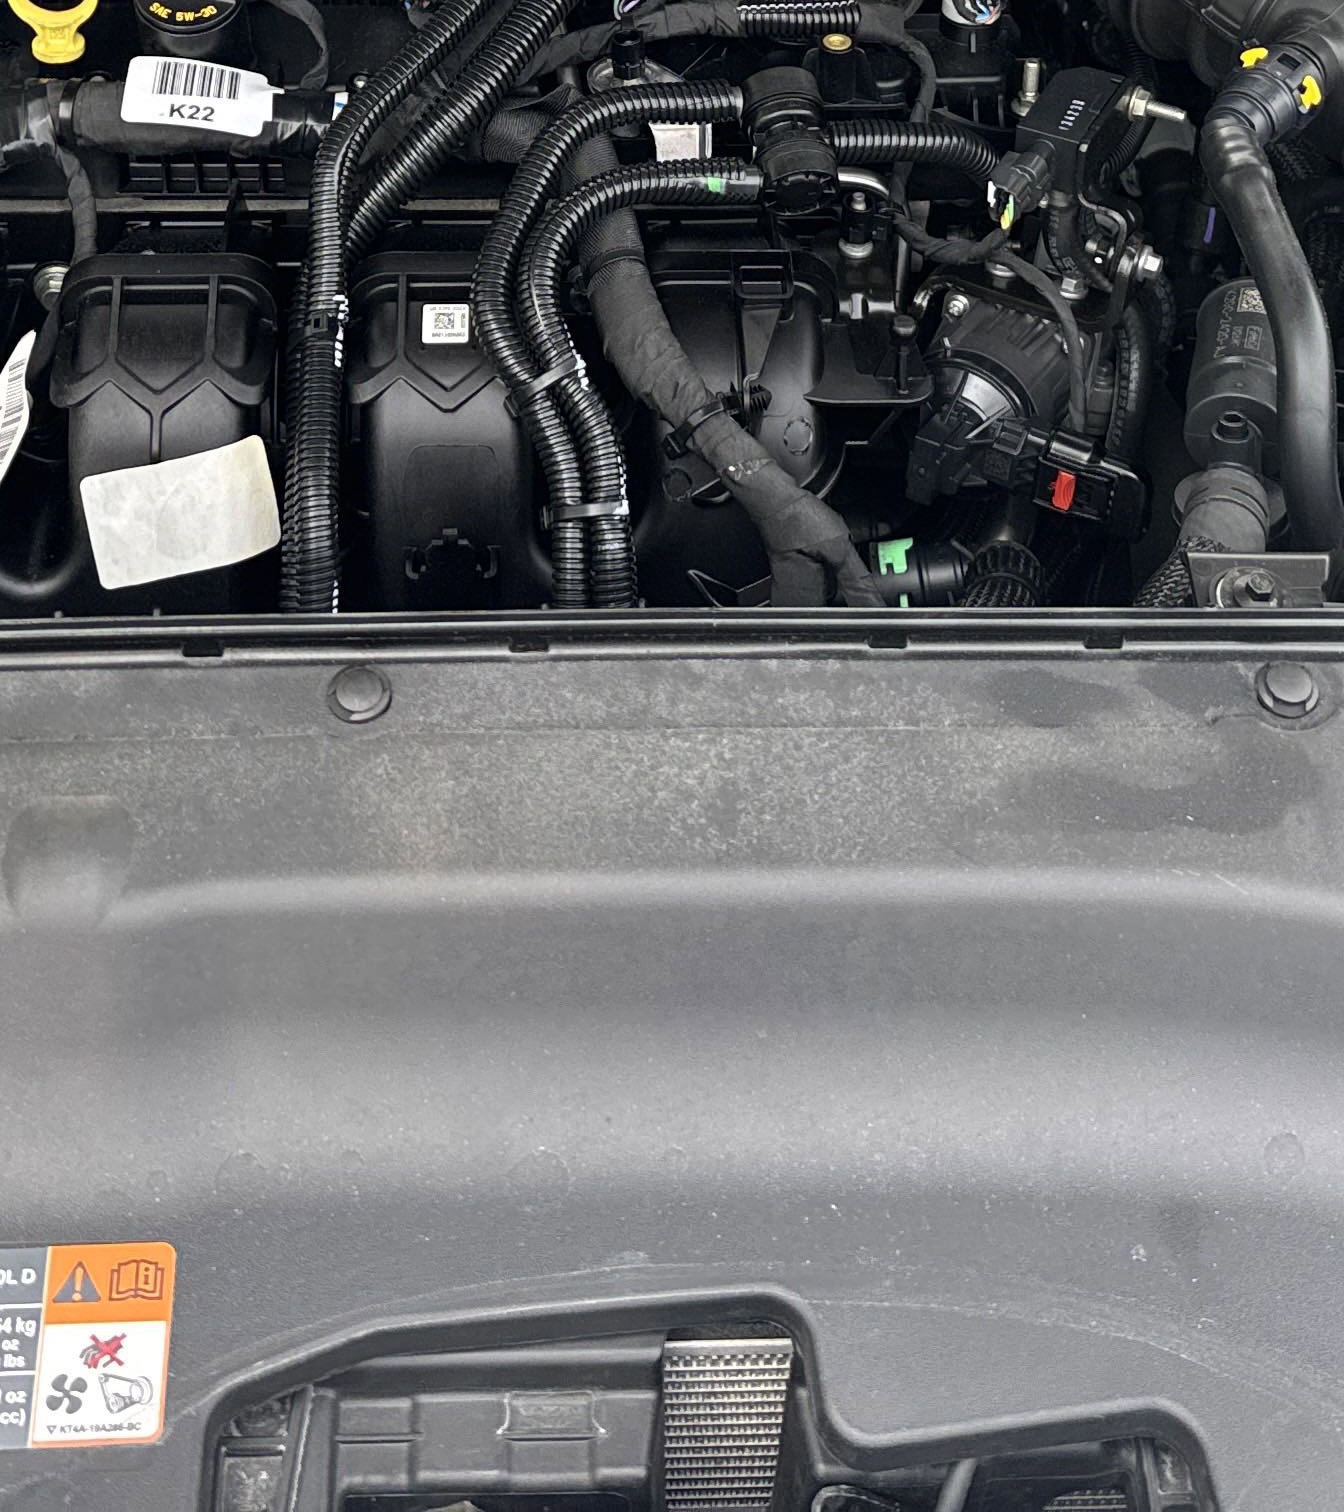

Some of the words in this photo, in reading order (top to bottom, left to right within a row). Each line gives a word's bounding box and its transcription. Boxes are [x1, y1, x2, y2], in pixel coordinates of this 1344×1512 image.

[149, 2, 173, 19] SAE
[175, 5, 218, 22] 5W-30
[169, 103, 215, 122] K22
[21, 1268, 37, 1284] D
[16, 1316, 37, 1338] kg
[1, 1339, 20, 1352] oz
[3, 1354, 26, 1368] lbs
[6, 1390, 27, 1404] oz
[0, 1408, 26, 1428] cc)
